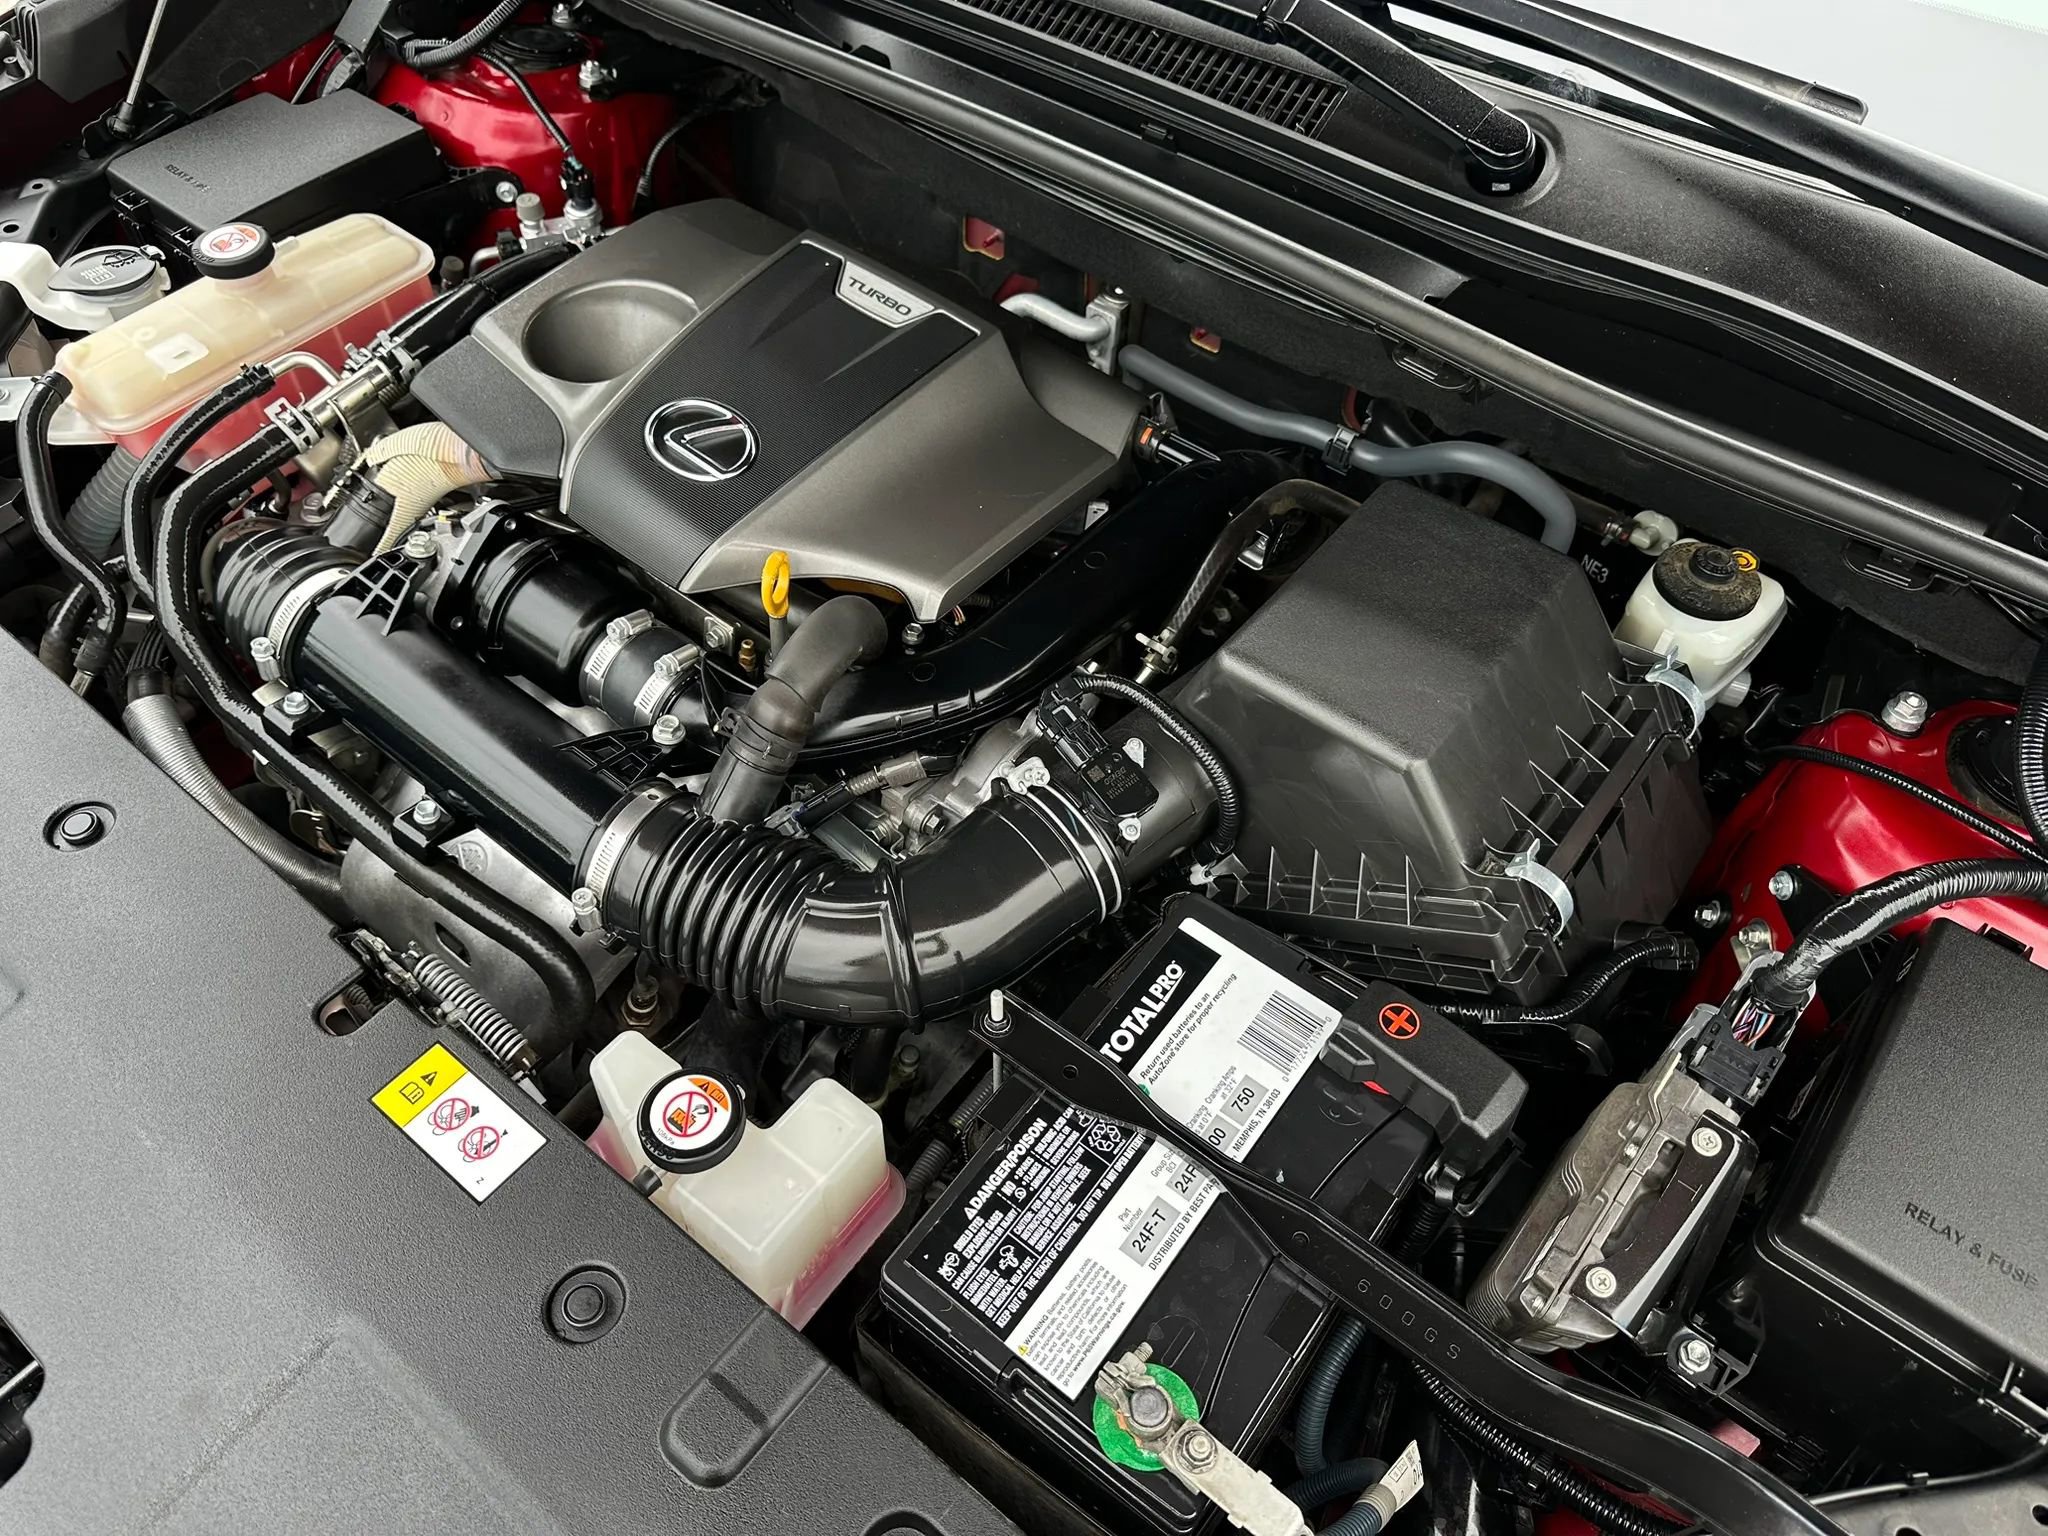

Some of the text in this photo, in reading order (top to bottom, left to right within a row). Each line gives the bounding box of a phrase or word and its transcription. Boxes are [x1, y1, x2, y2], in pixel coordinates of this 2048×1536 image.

[849, 276, 912, 316] TURBO
[1581, 553, 1609, 584] NE3
[1172, 1032, 1189, 1051] store
[1185, 1021, 1198, 1033] for
[1193, 1000, 1215, 1024] proper
[1209, 972, 1238, 1003] recycling
[1139, 991, 1210, 1079] Return used batteries to an
[1204, 1064, 1237, 1105] Cranking Amps
[1218, 1090, 1228, 1099] at
[1231, 1086, 1256, 1113] 750
[1034, 1106, 1074, 1154] SULFURIC ACID CAN
[1196, 1121, 1206, 1130] at
[1206, 1126, 1227, 1147] 00
[1042, 1125, 1072, 1159] BLINDNESS OR
[1049, 1129, 1080, 1165] SEVERE BURNS
[968, 1116, 1048, 1210] DANGER/POISON
[1015, 1155, 1034, 1177] SPARKS
[1023, 1161, 1042, 1183] FLAMES
[1077, 1165, 1091, 1180] SEEK
[1105, 1168, 1119, 1182] NOT
[1113, 1155, 1129, 1172] OPEN
[1150, 1147, 1176, 1178] Group Siz
[1165, 1160, 1177, 1173] BCI
[1000, 1179, 1017, 1196] NO
[1030, 1165, 1051, 1189] SMOKING
[1030, 1199, 1043, 1212] FOR
[1038, 1185, 1054, 1202] JUMP
[1065, 1145, 1085, 1166] FOLLOW
[1099, 1179, 1111, 1190] DO
[1148, 1222, 1185, 1270] DISTRIBUTED
[1181, 1210, 1193, 1223] BY
[1188, 1194, 1205, 1213] BEST
[1232, 1116, 1260, 1152] MEMPHIS,
[1255, 1107, 1267, 1119] TN
[1262, 1087, 1281, 1109] 38103
[1020, 1161, 1083, 1241] INSTRUCTIONS IN VEHICLE OWNERS
[1082, 1197, 1097, 1212] NOT
[1091, 1187, 1105, 1200] TIP.
[1047, 1211, 1056, 1220] IF
[1051, 1201, 1064, 1215] NOT
[1076, 1209, 1089, 1221] DO
[1117, 1207, 1131, 1222] Part
[1122, 1206, 1143, 1232] Number
[953, 1215, 985, 1252] SHIELD EYES
[962, 1209, 1003, 1259] EXPLOSIVE GASES
[1027, 1223, 1047, 1246] MANUAL
[1041, 1216, 1052, 1227] OR
[1053, 1218, 1081, 1251] CHILDREN.
[1130, 1208, 1168, 1253] 24F-T
[951, 1208, 1018, 1290] CAN CAUSE BLINDNESS OR INJURY
[1034, 1228, 1055, 1252] SERVICE
[1904, 1202, 2040, 1290] RELAY & FUSE
[1047, 1247, 1059, 1260] OF
[1032, 1256, 1053, 1279] REACH
[962, 1266, 990, 1299] FLUSH EYES
[970, 1269, 1000, 1305] IMMEDIATELY
[984, 1254, 1035, 1318] GET MEDICAL HELP FAST.
[1016, 1287, 1029, 1300] OF
[1023, 1274, 1039, 1291] THE
[977, 1294, 993, 1311] WITH
[1007, 1296, 1023, 1312] OUT
[1023, 1314, 1049, 1346] WARNING
[1064, 1271, 1081, 1291] battery
[1025, 1338, 1042, 1358] battery
[1055, 1304, 1066, 1316] and
[1063, 1287, 1078, 1305] related
[1075, 1260, 1098, 1288] accessories
[1031, 1264, 1105, 1362] can expose you to chemicals including
[995, 1309, 1013, 1329] KEEP
[1037, 1353, 1048, 1366] lead
[1047, 1341, 1057, 1353] and
[1055, 1327, 1067, 1341] lead
[1088, 1278, 1102, 1295] which
[1100, 1269, 1110, 1279] are
[1043, 1273, 1116, 1371] known to the State of California to cause
[1049, 1278, 1121, 1376] cancer and birth defects or other
[1055, 1347, 1082, 1382] reproductive
[1088, 1323, 1098, 1334] For
[1095, 1310, 1108, 1325] more
[1104, 1282, 1127, 1311] information
[1061, 1376, 1071, 1387] go
[1067, 1370, 1075, 1378] to
